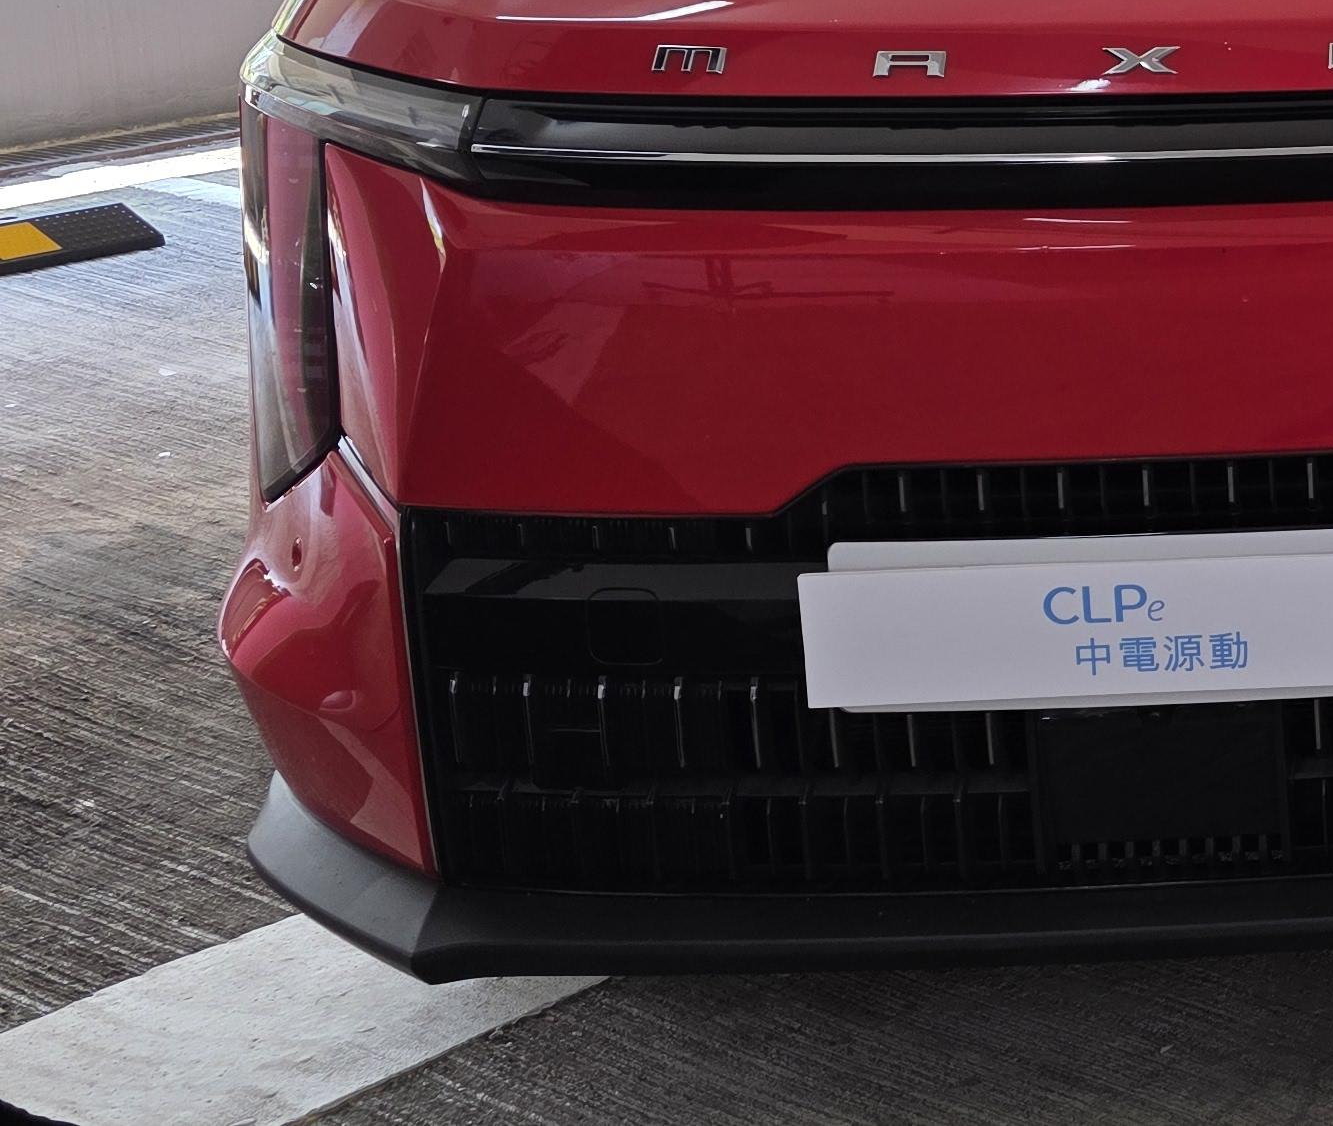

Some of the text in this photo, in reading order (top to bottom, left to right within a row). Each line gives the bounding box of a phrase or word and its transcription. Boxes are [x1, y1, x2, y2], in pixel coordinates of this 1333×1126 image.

[1043, 584, 1165, 625] CLPe
[1075, 631, 1249, 676] 中電源動
